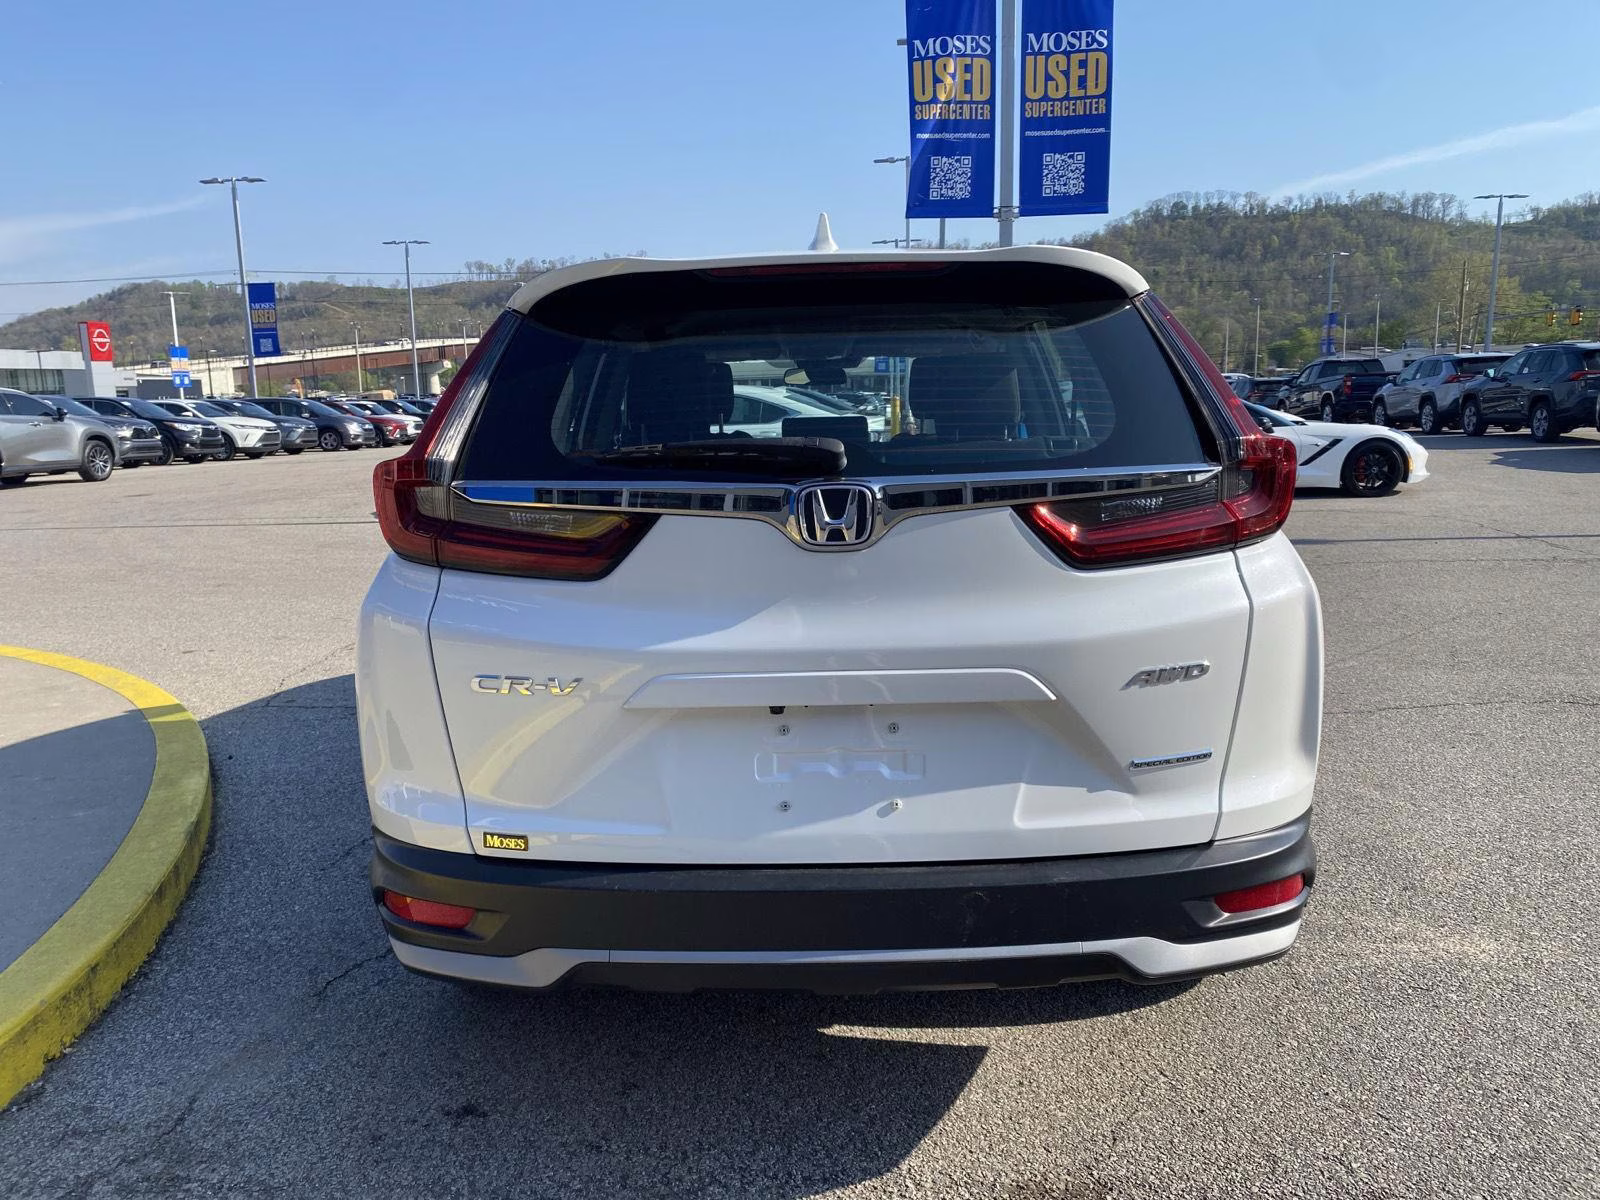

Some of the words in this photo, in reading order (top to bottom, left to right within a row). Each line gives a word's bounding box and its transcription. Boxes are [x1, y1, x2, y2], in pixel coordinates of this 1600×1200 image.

[912, 35, 991, 58] MOSES
[1026, 29, 1108, 53] MOSES
[912, 57, 991, 103] USED
[1025, 51, 1108, 100] USED
[915, 103, 991, 120] SUPERCENTER
[1025, 98, 1107, 119] SUPERCENTER
[915, 132, 991, 140] mosesusedsupercenter.com
[1025, 127, 1106, 137] mosesusedsupercenter.com
[251, 310, 275, 323] USED
[470, 674, 585, 697] CR-V
[1118, 660, 1211, 691] AWD
[1133, 758, 1174, 769] SPECIAL
[1176, 751, 1213, 764] EDITION
[486, 835, 525, 850] MOSES
